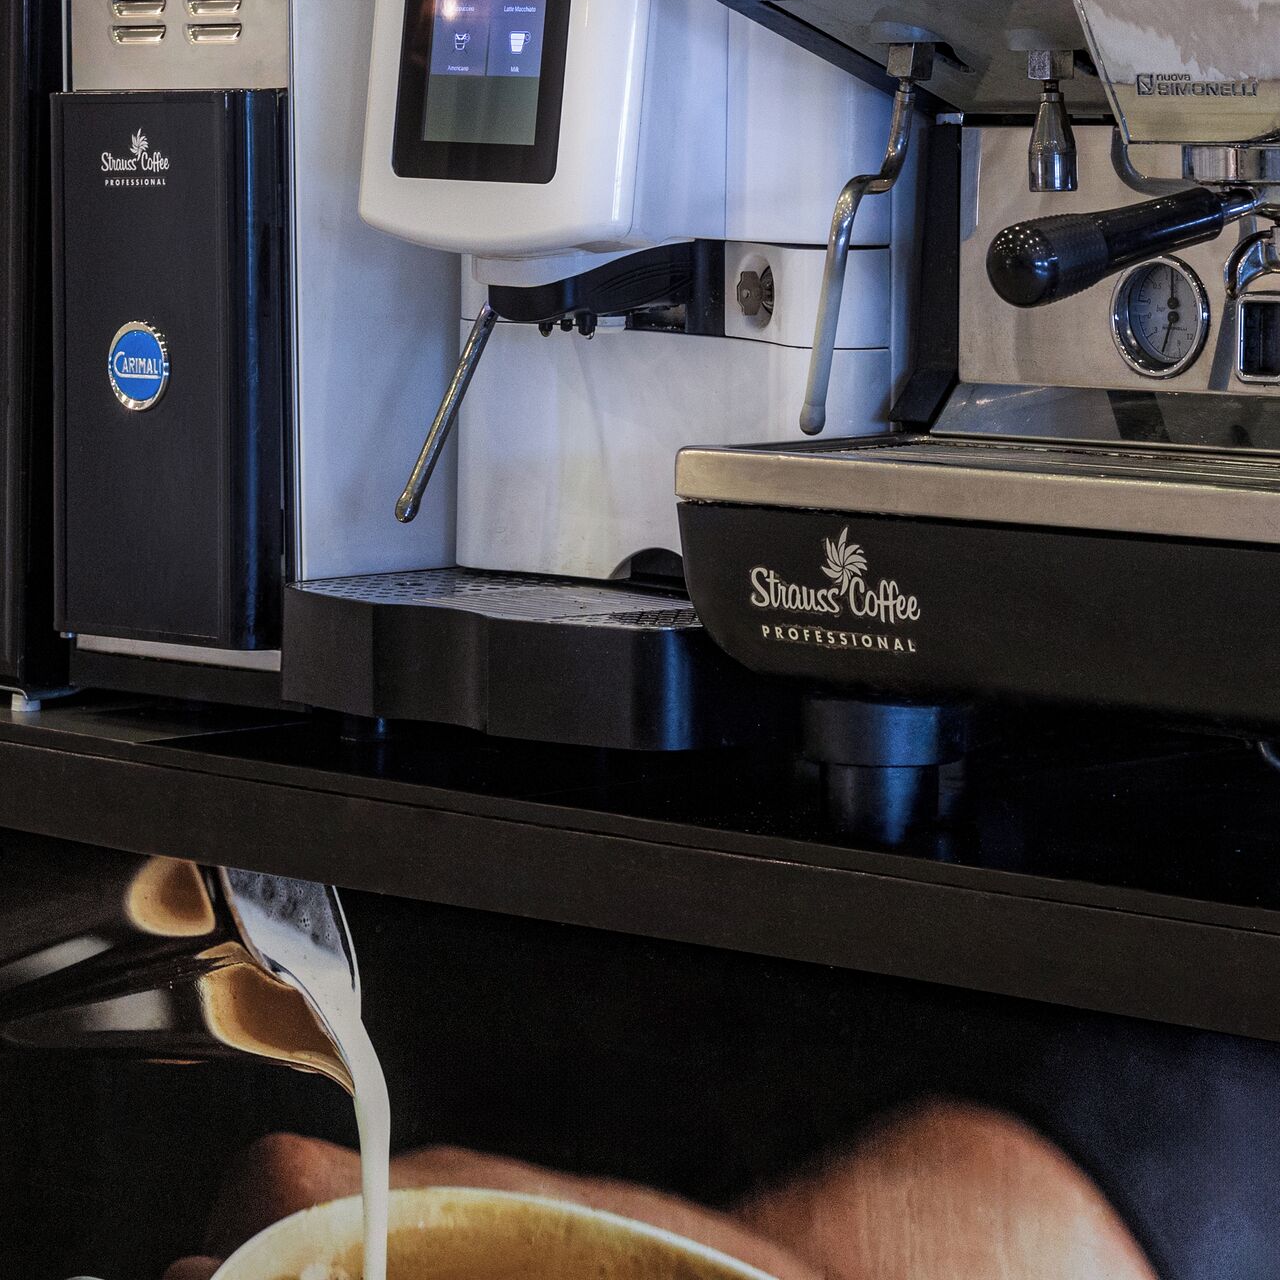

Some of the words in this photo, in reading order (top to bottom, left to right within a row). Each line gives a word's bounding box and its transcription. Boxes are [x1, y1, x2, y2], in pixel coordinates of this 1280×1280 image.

[1156, 73, 1191, 81] nuova
[1157, 81, 1257, 97] SIMONELLI
[101, 152, 137, 171] Strauss
[141, 152, 170, 172] Coffee
[114, 351, 162, 379] CARIMALI
[750, 567, 840, 614] Strauss
[849, 576, 920, 624] Coffee
[761, 625, 916, 652] PROFESSIONAL
